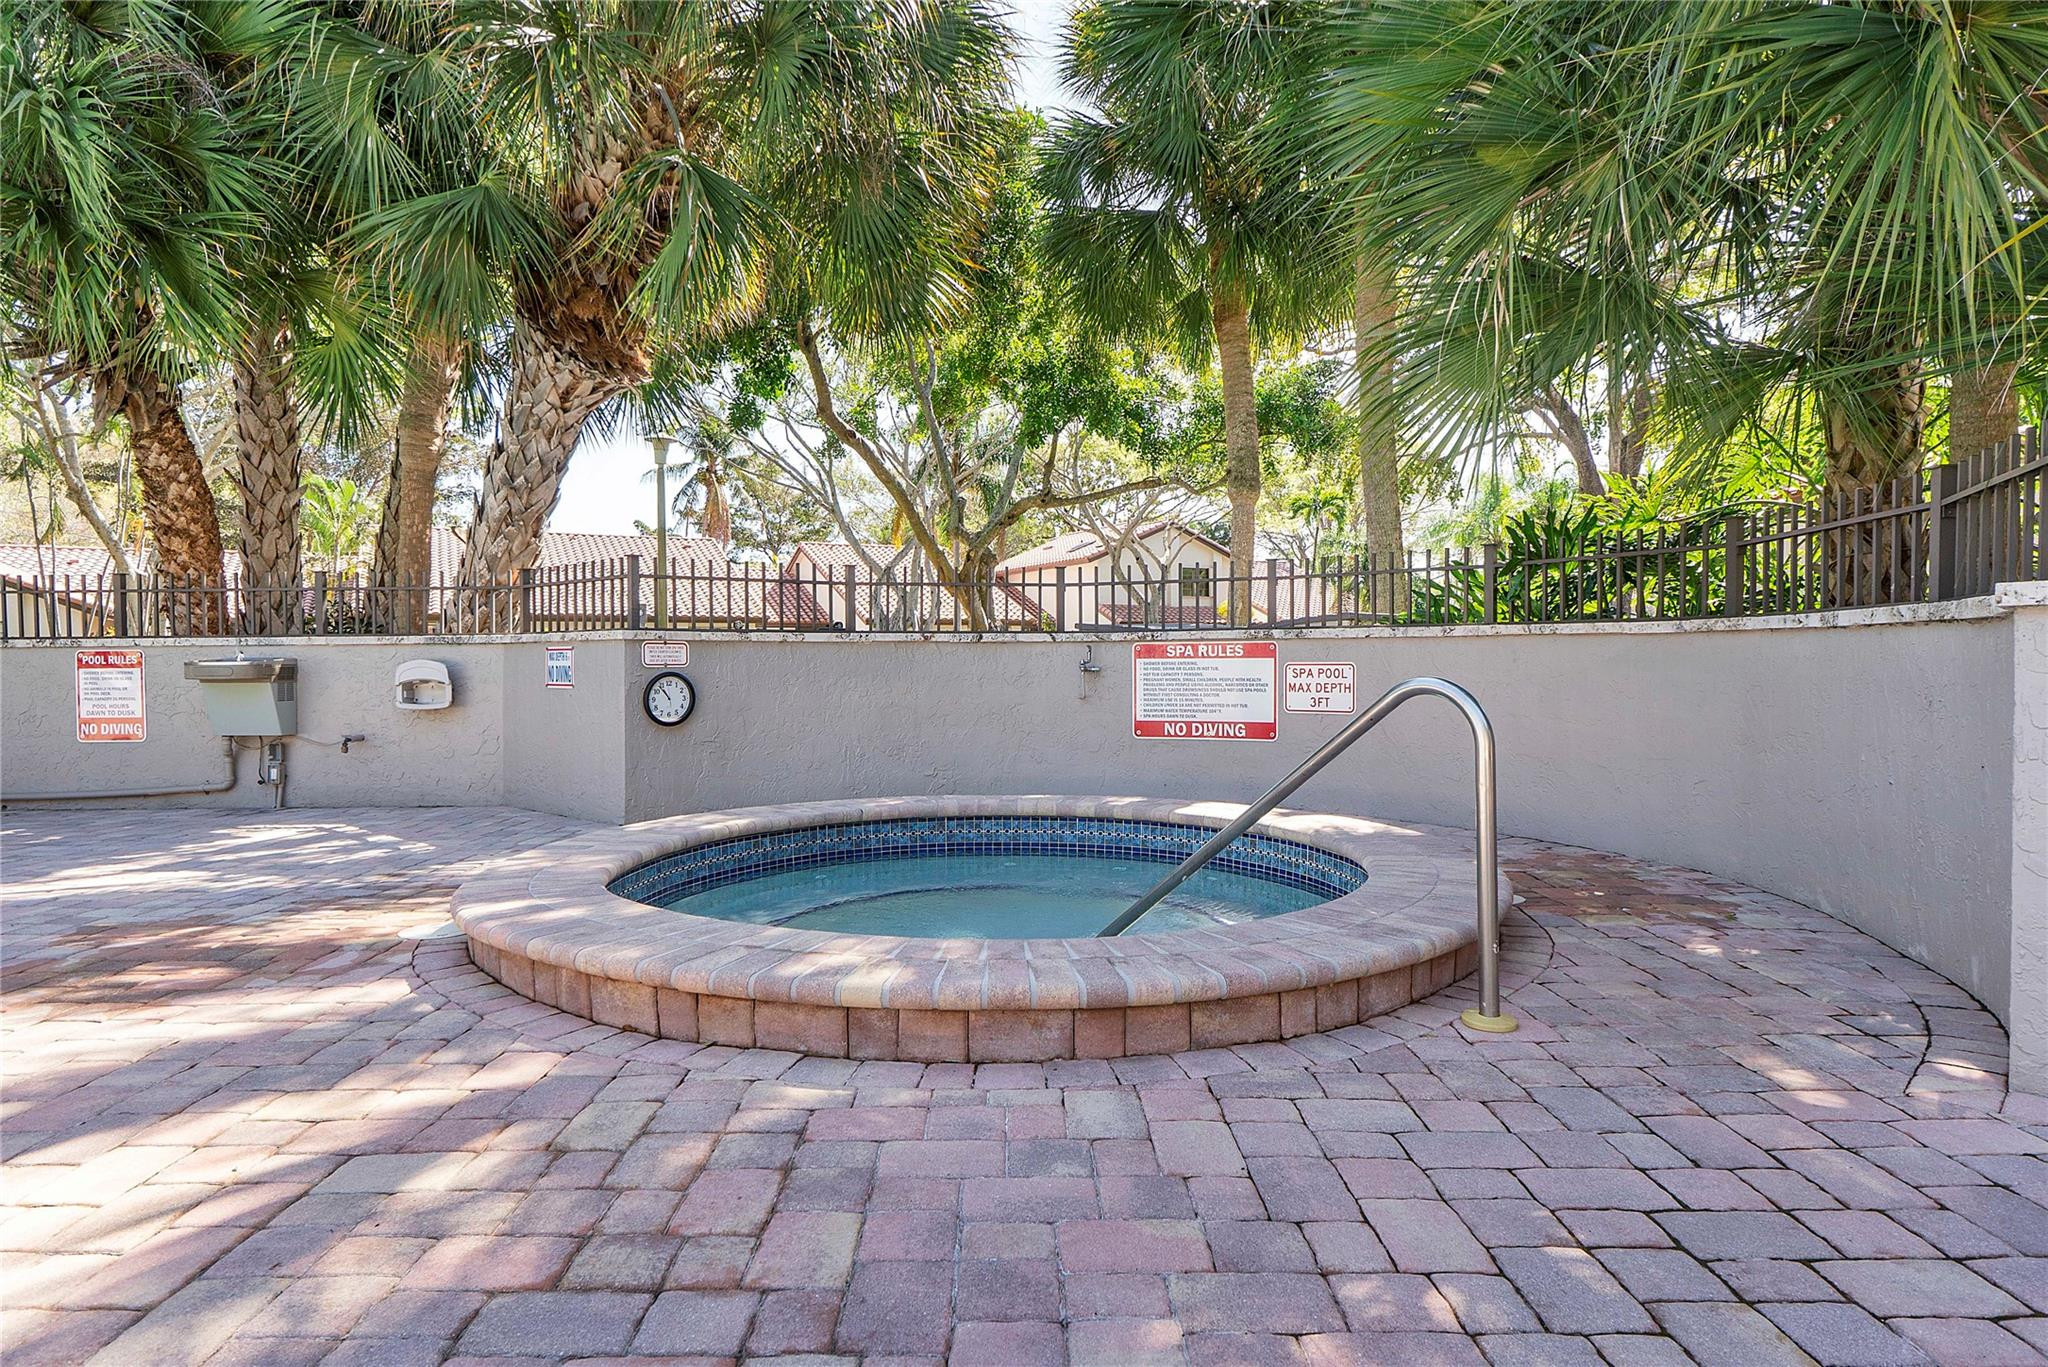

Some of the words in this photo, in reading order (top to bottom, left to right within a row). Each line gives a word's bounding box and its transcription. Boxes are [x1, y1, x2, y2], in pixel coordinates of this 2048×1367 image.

[1166, 645, 1194, 657] SPA
[1198, 645, 1244, 657] RULES
[82, 656, 106, 664] POOL
[108, 656, 137, 664] RULES
[556, 666, 571, 682] DIVING
[1292, 668, 1314, 678] SPA
[1318, 668, 1348, 678] POOL
[1289, 682, 1311, 693] MAX
[1315, 682, 1351, 693] DEPTH
[1310, 697, 1330, 708] 3FT
[81, 723, 97, 735] NO
[101, 723, 142, 735] DIVING
[1164, 722, 1187, 736] NO
[1192, 722, 1246, 736] DIVING
